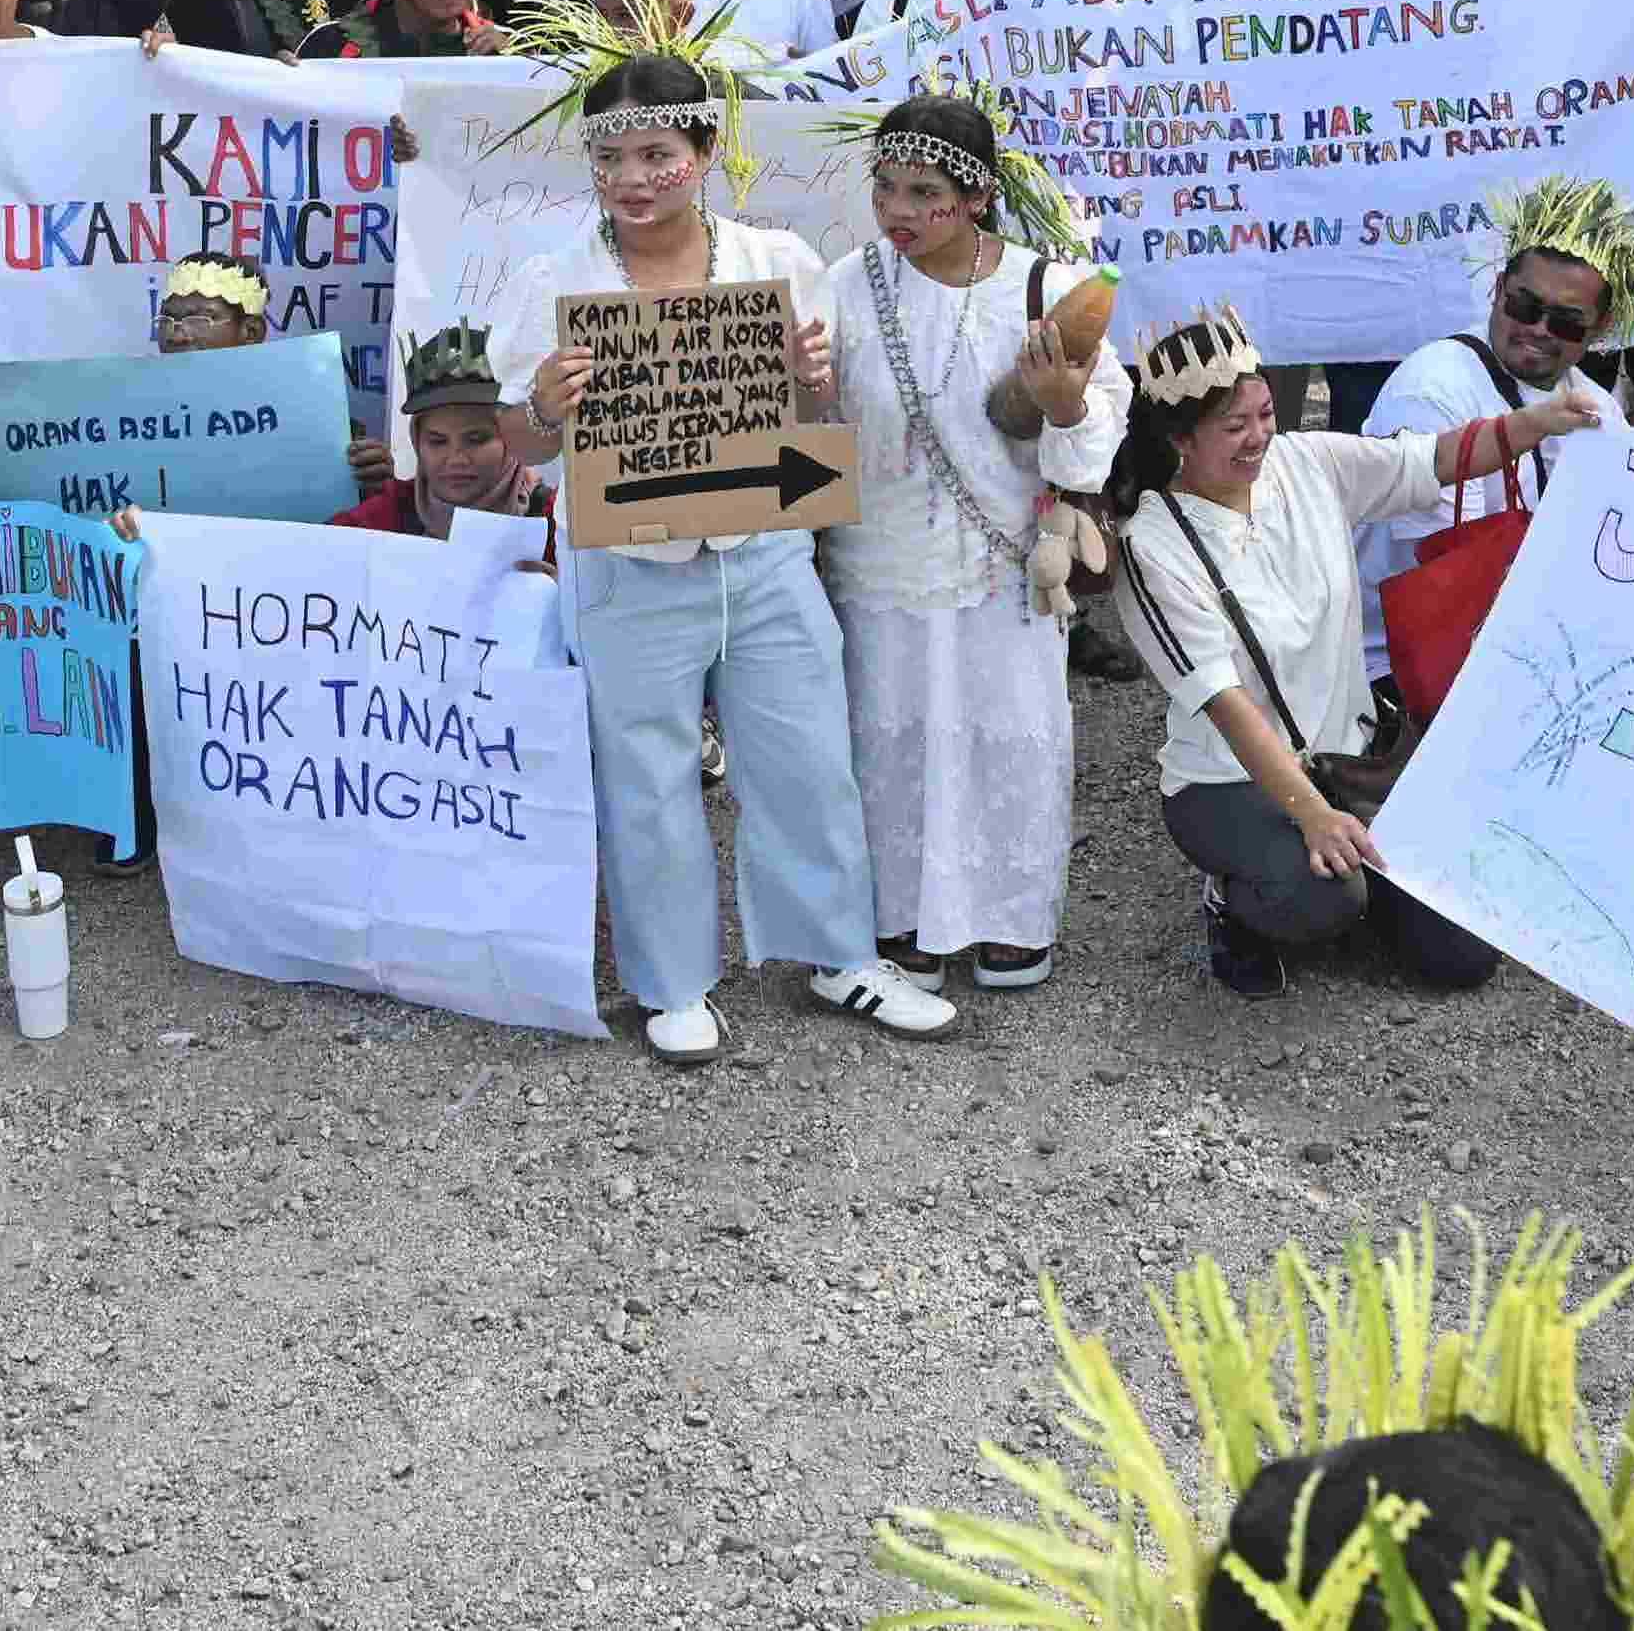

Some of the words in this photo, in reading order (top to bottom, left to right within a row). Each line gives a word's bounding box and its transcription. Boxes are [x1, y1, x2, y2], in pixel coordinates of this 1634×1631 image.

[1003, 23, 1176, 82] BUKAN
[1392, 91, 1514, 130] TANAH
[148, 111, 322, 200] KAMI
[1226, 135, 1432, 172] MENAKUTKAN
[1142, 217, 1344, 265] PADAMKAN
[1360, 201, 1494, 247] SUARA
[567, 302, 641, 333] KAMI
[653, 289, 782, 322] TERPAKSA
[672, 324, 711, 355] AIR
[723, 321, 785, 351] KOTOR
[677, 353, 786, 385] DARIPADA
[734, 381, 790, 410] YANG
[6, 414, 107, 454] ORANG
[205, 404, 278, 440] ADA
[574, 419, 659, 453] DILULUS
[667, 406, 783, 443] KERAJAAN
[618, 439, 713, 477] NEGERI
[60, 471, 134, 516] HAK
[197, 581, 500, 703] HORMATI
[173, 661, 294, 740] HAK
[319, 678, 523, 773] TANAH
